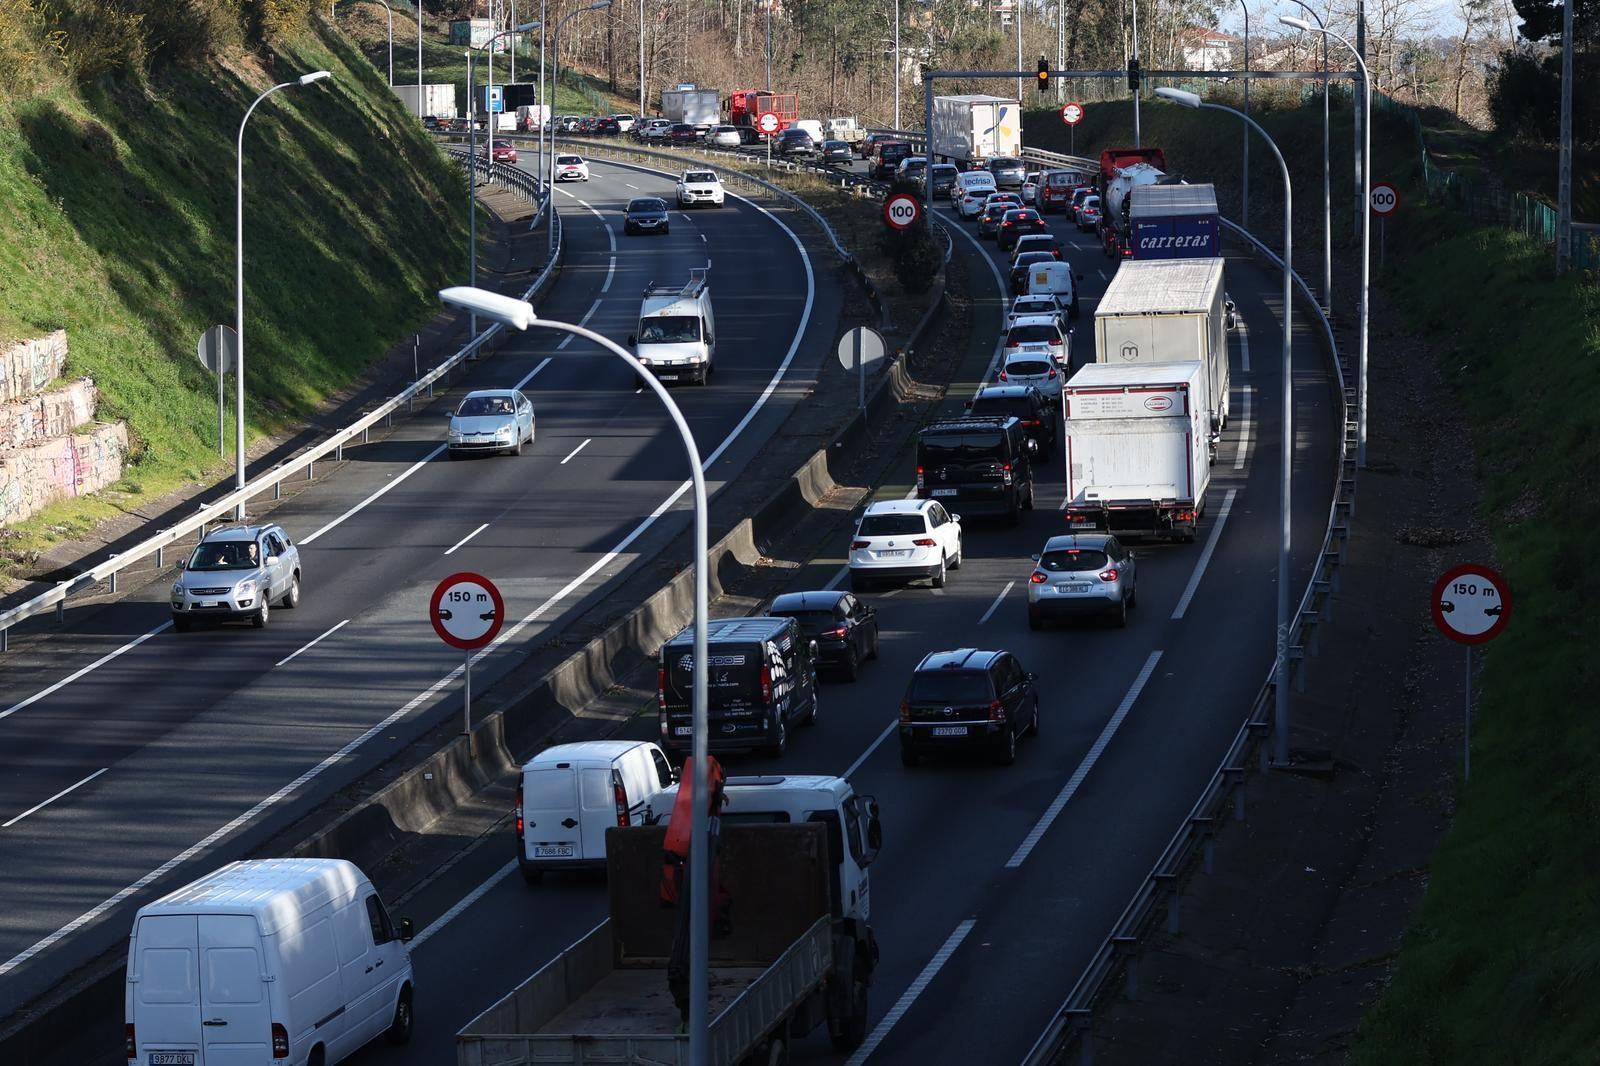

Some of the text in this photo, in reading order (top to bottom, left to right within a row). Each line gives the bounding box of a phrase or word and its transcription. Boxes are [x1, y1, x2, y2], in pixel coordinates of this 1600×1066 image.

[1372, 193, 1395, 205] 100
[891, 206, 914, 217] 100
[1140, 234, 1210, 248] carreras
[1453, 583, 1494, 596] 150 m
[448, 591, 487, 602] 150 m
[154, 1055, 175, 1063] 9877
